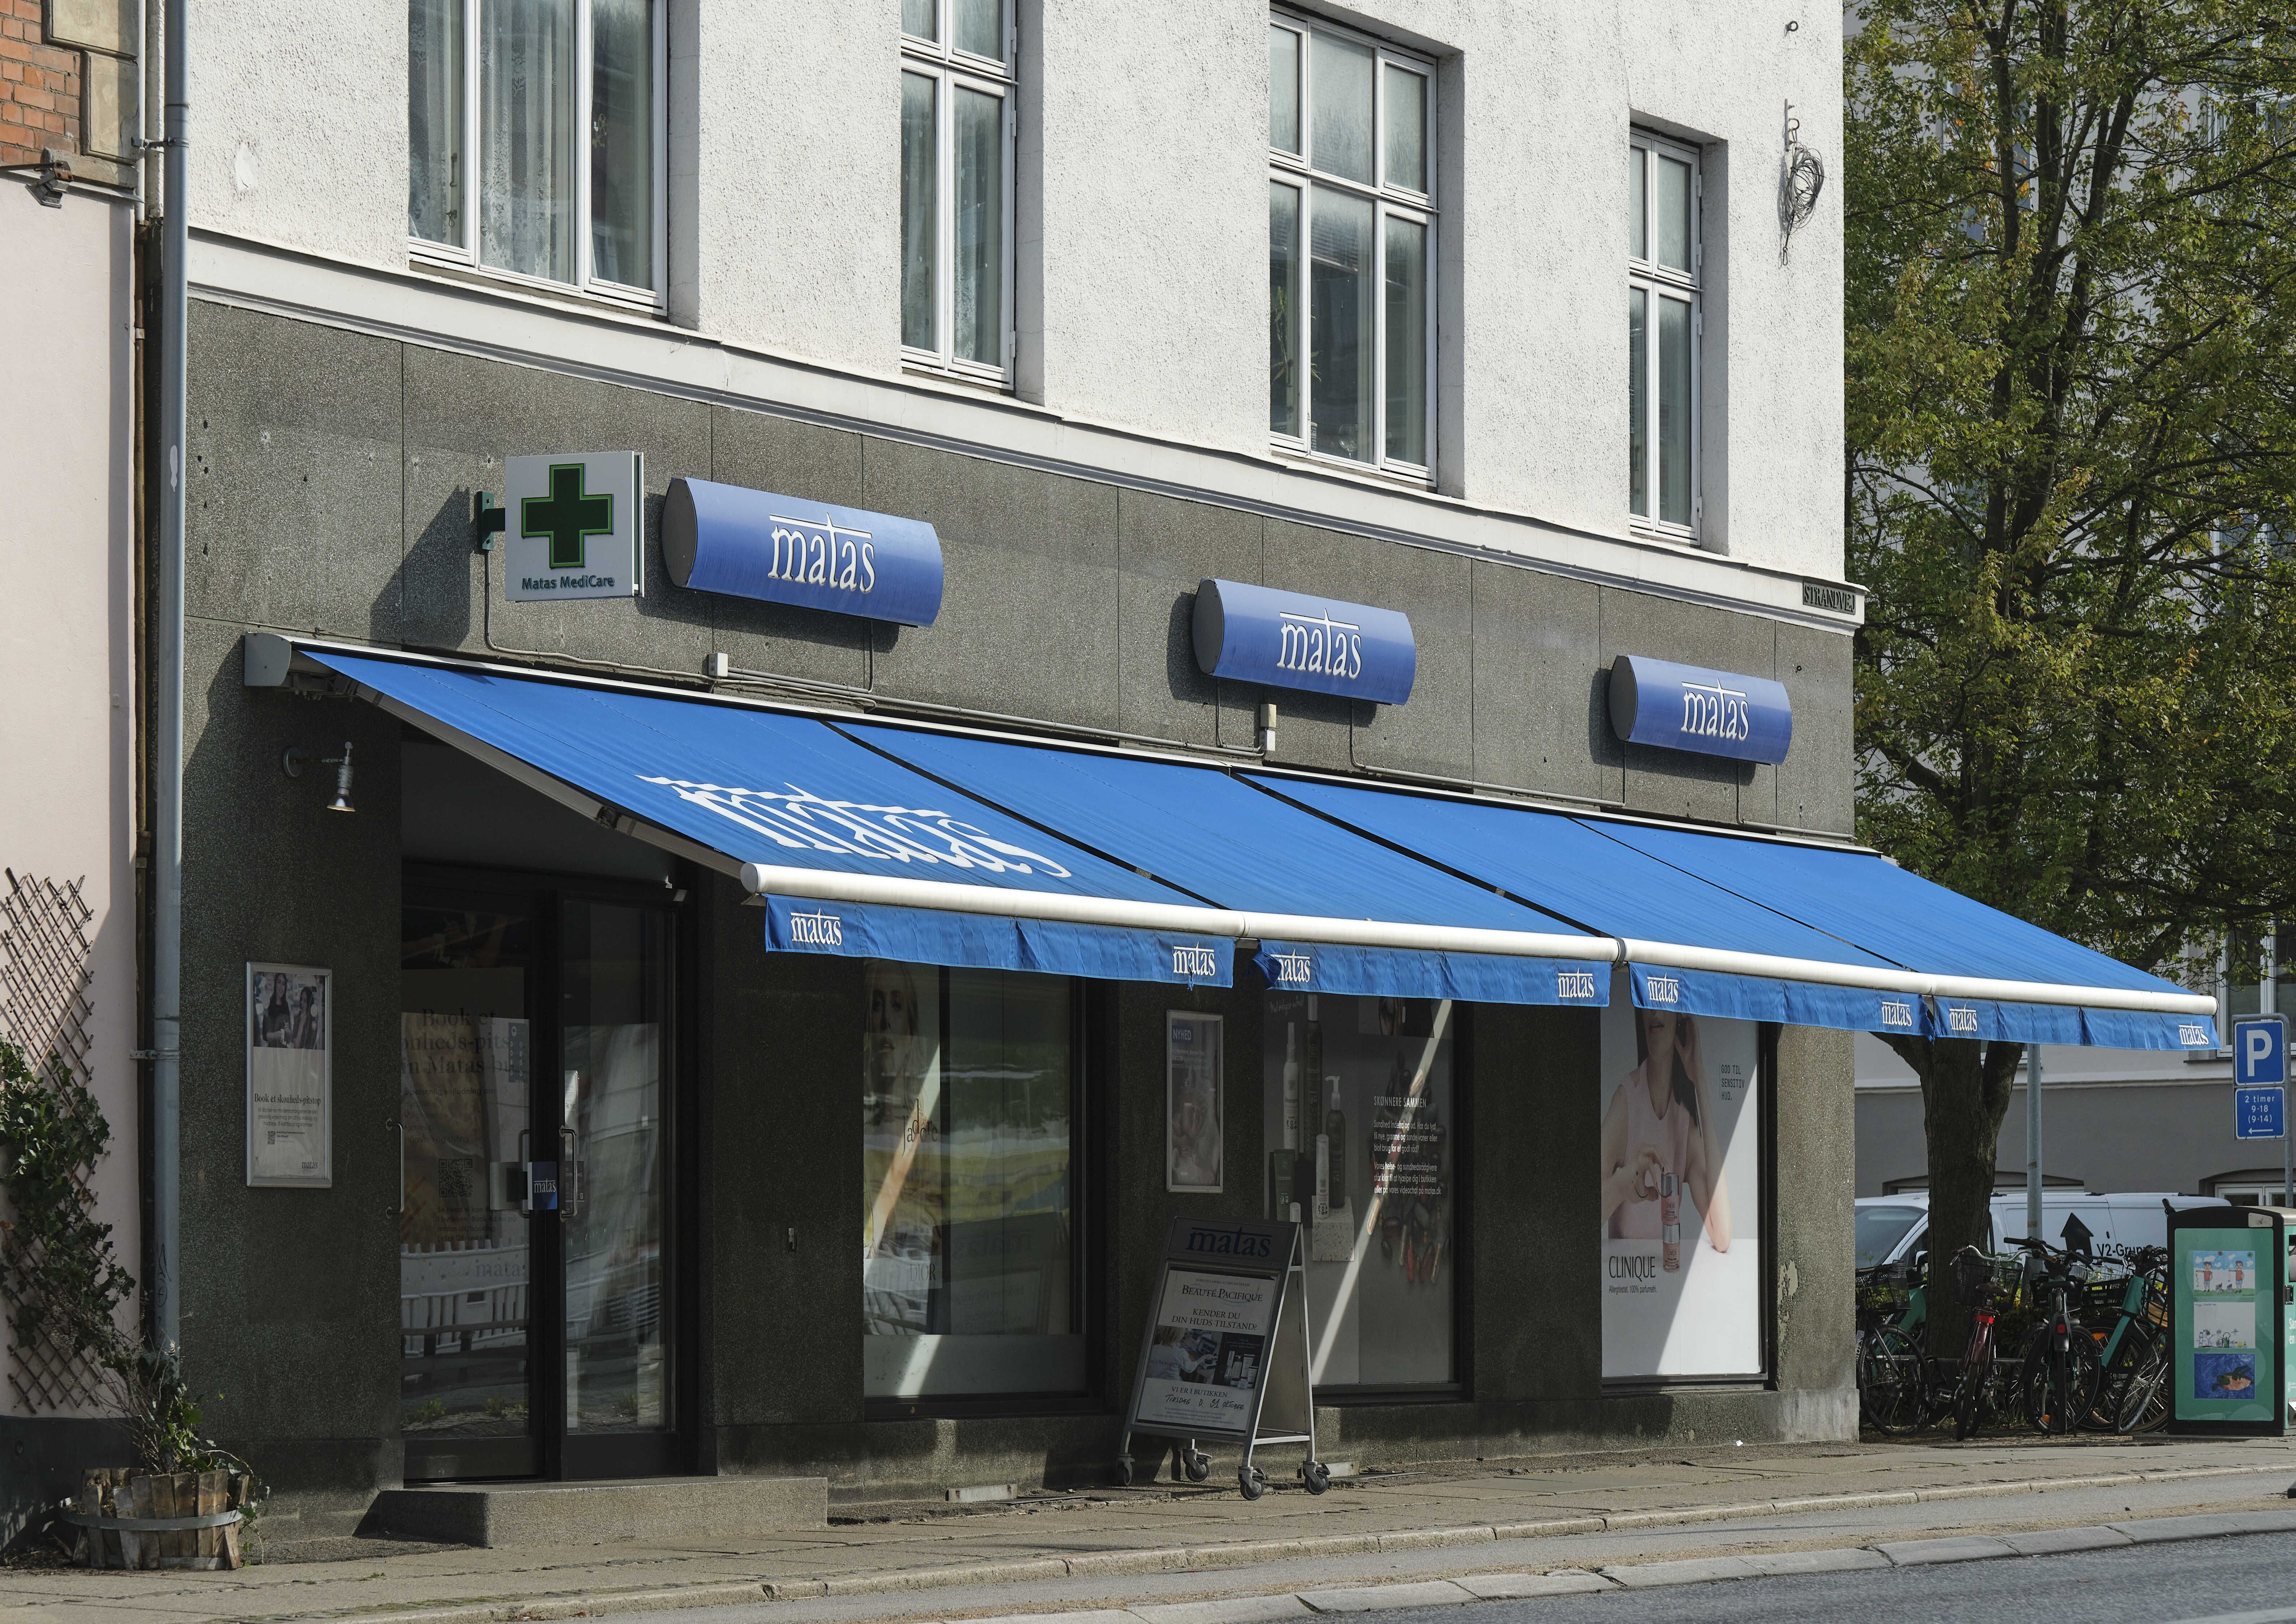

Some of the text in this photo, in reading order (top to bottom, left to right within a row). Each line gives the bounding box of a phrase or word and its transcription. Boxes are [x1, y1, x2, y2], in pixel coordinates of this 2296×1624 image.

[767, 513, 876, 594] matas
[522, 576, 615, 590] Matas MediCare
[1804, 585, 1855, 612] STRANDVEJ
[1276, 608, 1362, 679] matas
[1681, 678, 1749, 742] matas
[635, 775, 1072, 878] matas
[790, 908, 842, 946] matas
[1173, 941, 1216, 976] matas
[1558, 968, 1595, 998] matas
[1647, 973, 1679, 1003] matas
[422, 1007, 474, 1026] Book
[1882, 998, 1913, 1027] matas
[1949, 1003, 1978, 1032] matas
[1173, 1029, 1192, 1041] NYHED
[2179, 1021, 2209, 1046] matas
[2247, 1030, 2273, 1077] P
[428, 1055, 484, 1074] Matas
[1721, 1064, 1741, 1074] GOD TIL
[1721, 1078, 1745, 1088] SENSITIV
[254, 1093, 269, 1102] Book
[277, 1094, 321, 1106] skønheds-pitstop
[1374, 1095, 1426, 1108] SKØNNERE SAMMEN
[1721, 1091, 1732, 1100] HUD.
[1374, 1120, 1390, 1128] Sundhed
[1387, 1134, 1400, 1142] grønne
[1400, 1134, 1406, 1142] og
[1407, 1133, 1418, 1142] sunde
[1382, 1144, 1391, 1153] brug
[1401, 1145, 1410, 1154] godt
[1411, 1144, 1420, 1153] råd?
[1403, 1162, 1437, 1173] sundhedsrådgivere
[534, 1178, 556, 1193] matas
[1398, 1174, 1411, 1184] hjælpe
[1421, 1175, 1436, 1183] butikken
[1383, 1186, 1388, 1196] på
[1399, 1186, 1418, 1194] videochat
[1418, 1187, 1424, 1196] på
[1424, 1186, 1442, 1195] matas.dk
[1186, 1227, 1272, 1258] matas
[910, 1263, 936, 1281] DIOR
[1609, 1256, 1656, 1282] CLINIQUE
[1193, 1308, 1226, 1318] KENDER
[1172, 1315, 1258, 1331] DIN HUDS TILSTAND?
[1194, 1389, 1228, 1397] BUTIKKEN
[1165, 1394, 1191, 1405] TIRSDAG
[1210, 1399, 1220, 1408] 31
[1222, 1401, 1244, 1410] OKTOBER
